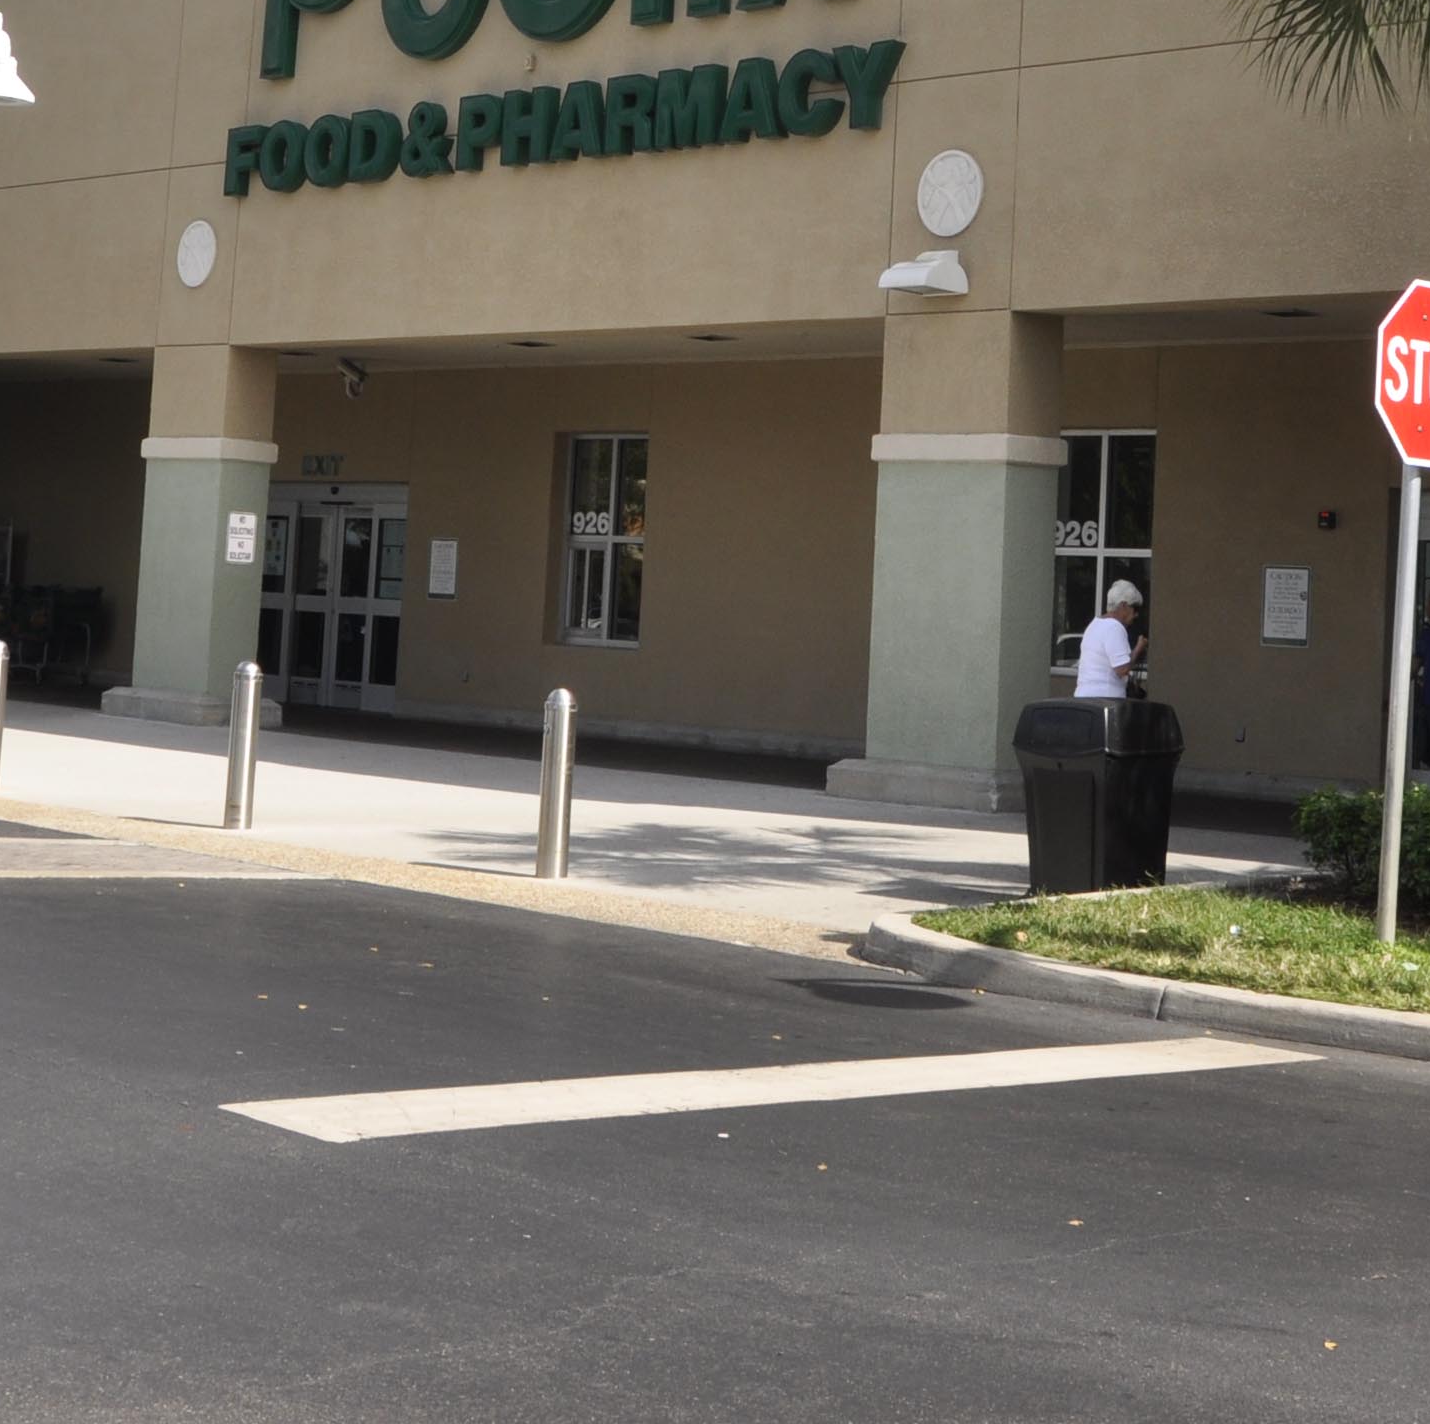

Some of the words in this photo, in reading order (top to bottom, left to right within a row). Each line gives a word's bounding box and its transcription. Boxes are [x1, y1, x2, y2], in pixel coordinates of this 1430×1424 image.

[223, 109, 402, 197] FOOD
[455, 40, 906, 172] PHARMACY
[302, 453, 347, 477] EXIT
[573, 511, 610, 535] 926
